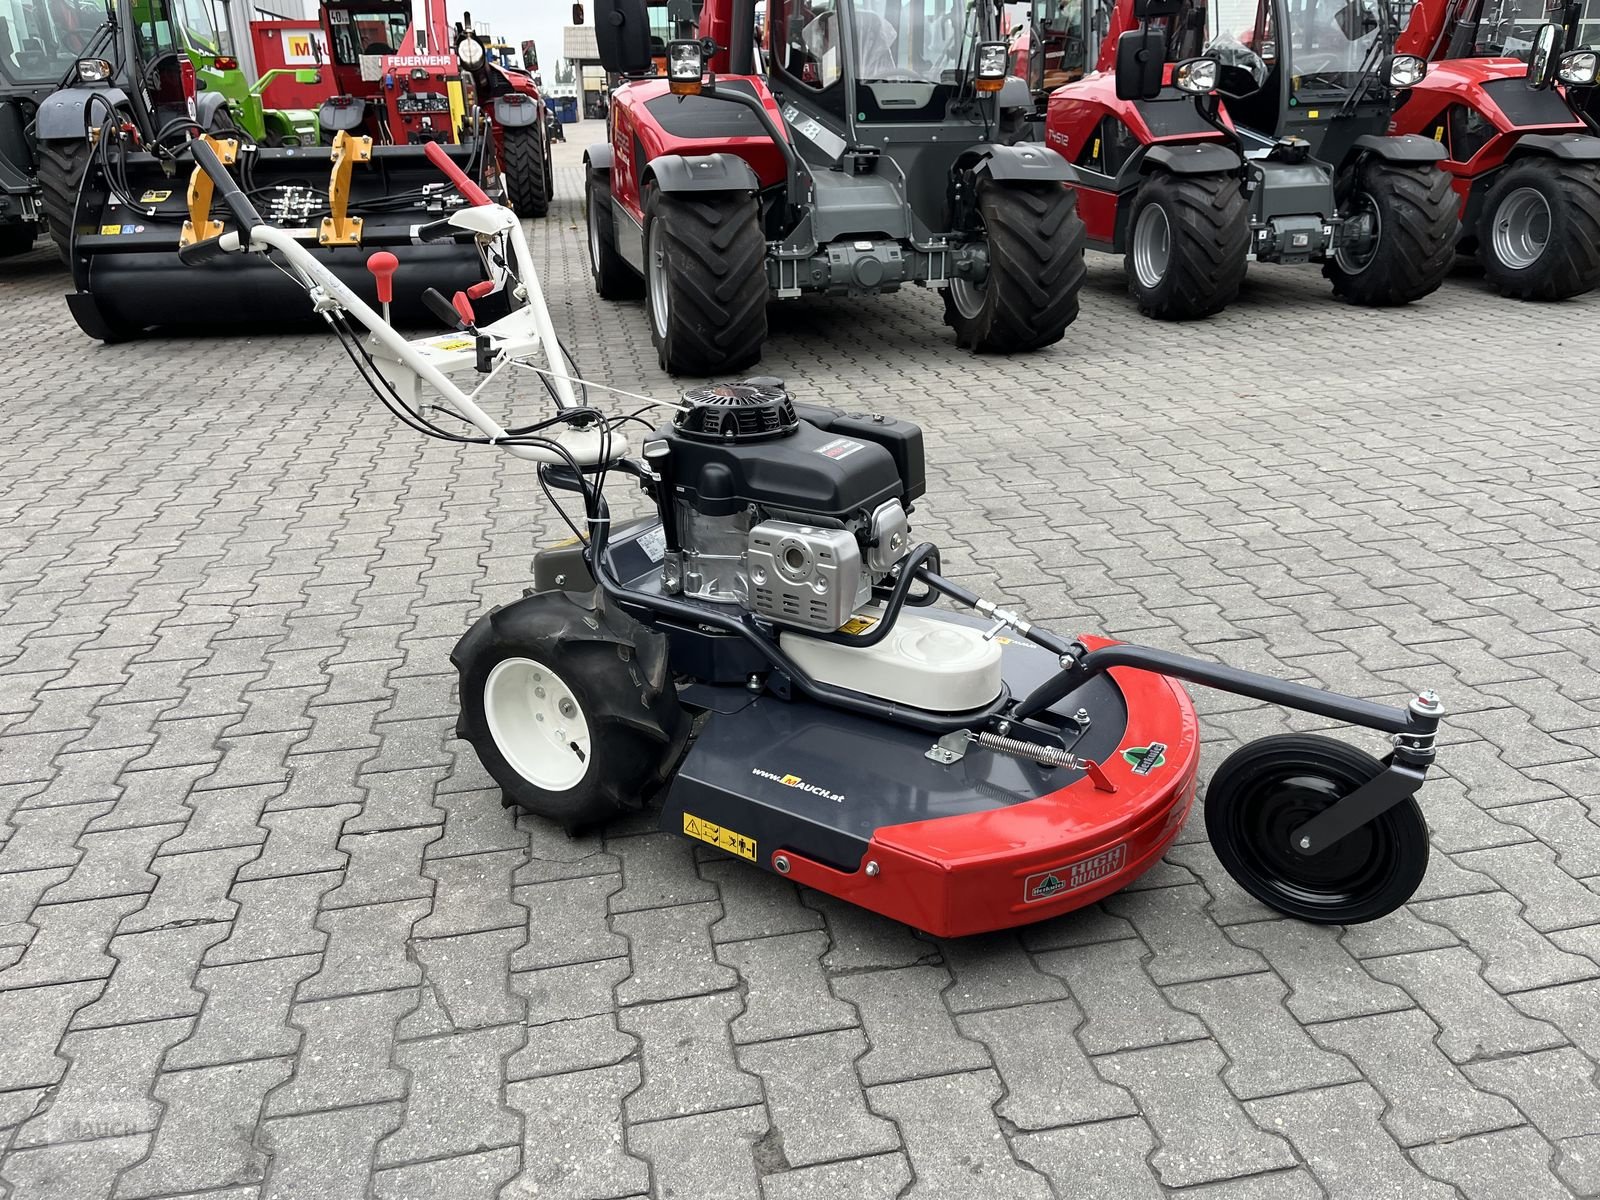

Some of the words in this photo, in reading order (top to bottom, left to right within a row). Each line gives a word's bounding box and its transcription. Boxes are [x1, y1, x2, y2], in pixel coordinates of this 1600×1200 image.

[331, 11, 341, 23] 40
[387, 56, 451, 66] FEUERWEHR
[752, 768, 845, 803] www.MAUCH.at
[1070, 859, 1120, 888] QUALITY
[1071, 848, 1121, 876] HIGH
